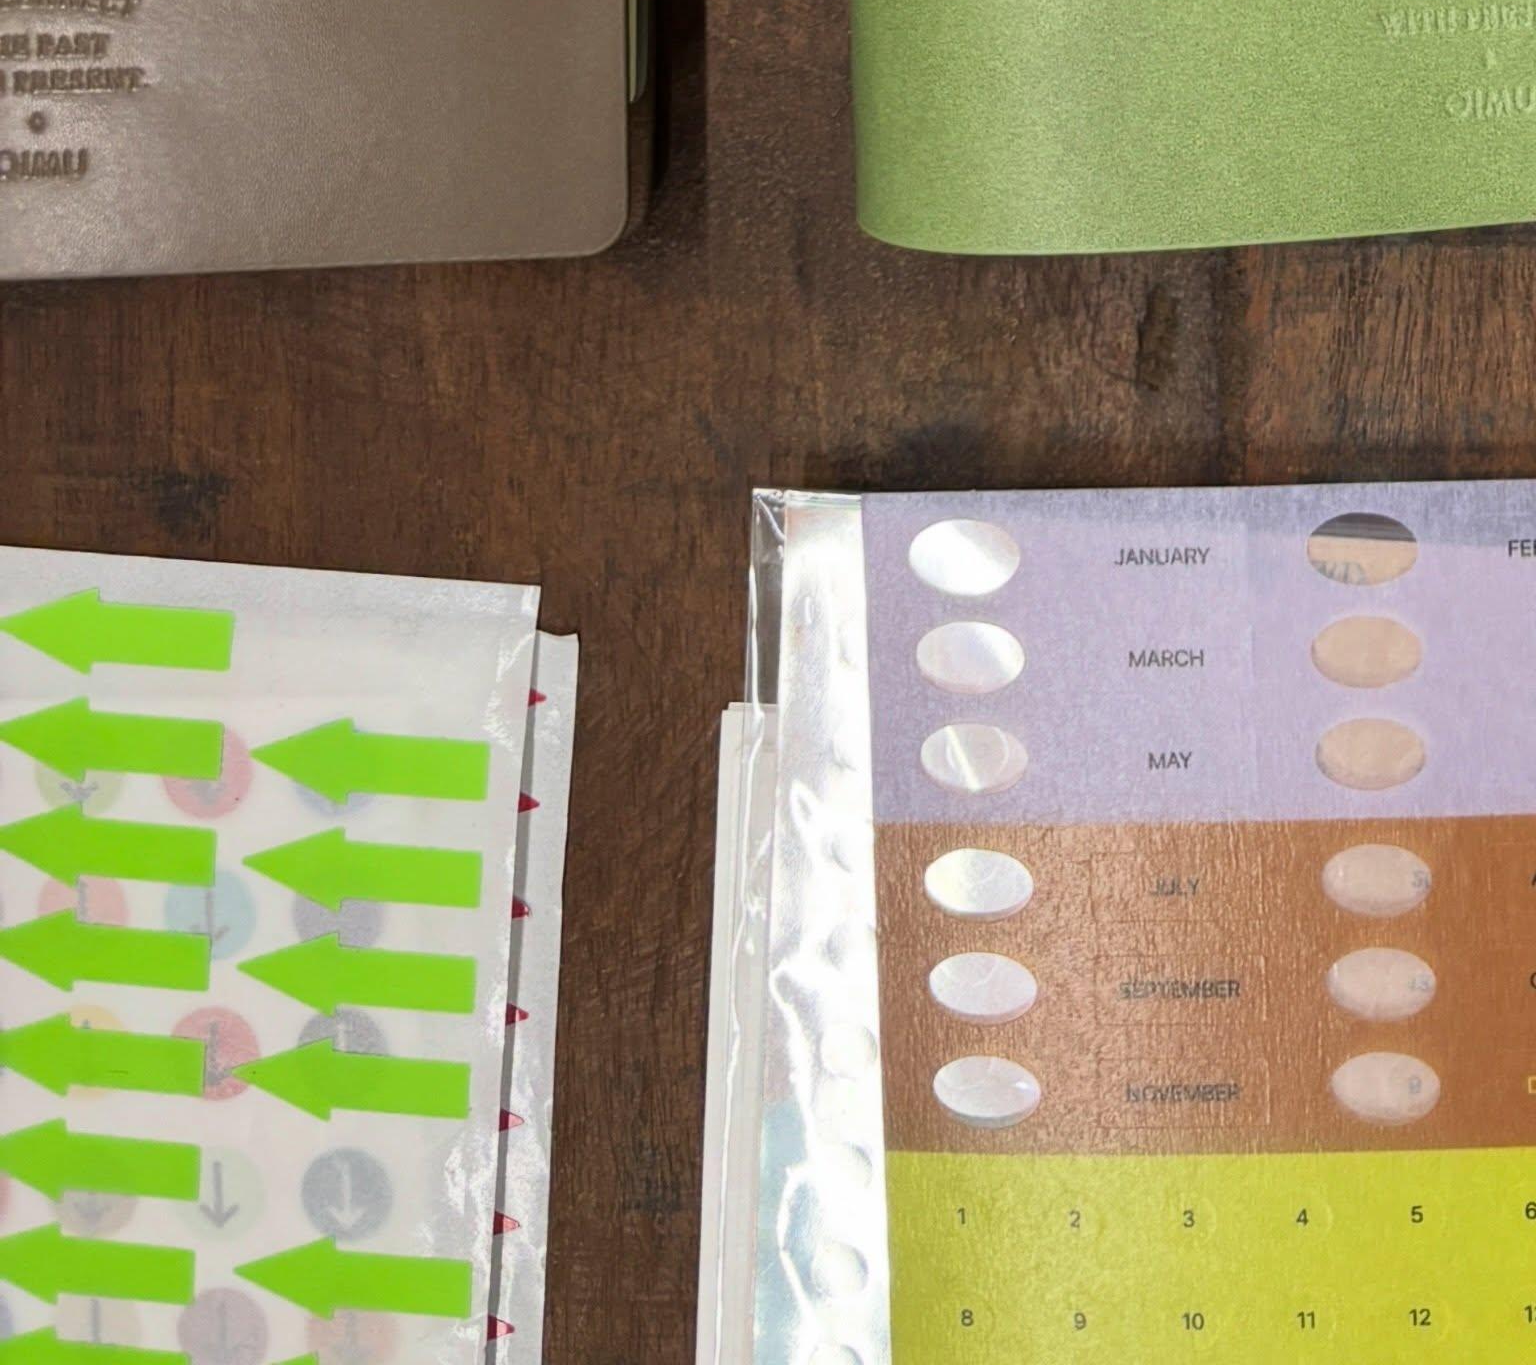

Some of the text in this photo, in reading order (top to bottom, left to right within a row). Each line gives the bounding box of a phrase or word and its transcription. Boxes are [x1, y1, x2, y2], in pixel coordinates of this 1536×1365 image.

[1377, 7, 1457, 37] WITH
[36, 32, 110, 56] PAST
[1114, 547, 1210, 566] JANUARY
[1128, 649, 1204, 668] MARCH
[1148, 751, 1192, 770] MAY
[1150, 878, 1200, 896] JULY
[1119, 980, 1241, 1000] SEPTEMBER
[1126, 1083, 1242, 1103] NOVEMBER
[956, 1207, 966, 1225] 1
[1069, 1209, 1082, 1228] 2
[1183, 1210, 1195, 1228] 3
[1296, 1209, 1309, 1226] 4
[1410, 1205, 1424, 1223] 5
[961, 1309, 974, 1326] 8
[1074, 1312, 1087, 1330] 9
[1181, 1312, 1205, 1330] 10
[1296, 1311, 1316, 1329] 11
[1409, 1308, 1432, 1326] 12
